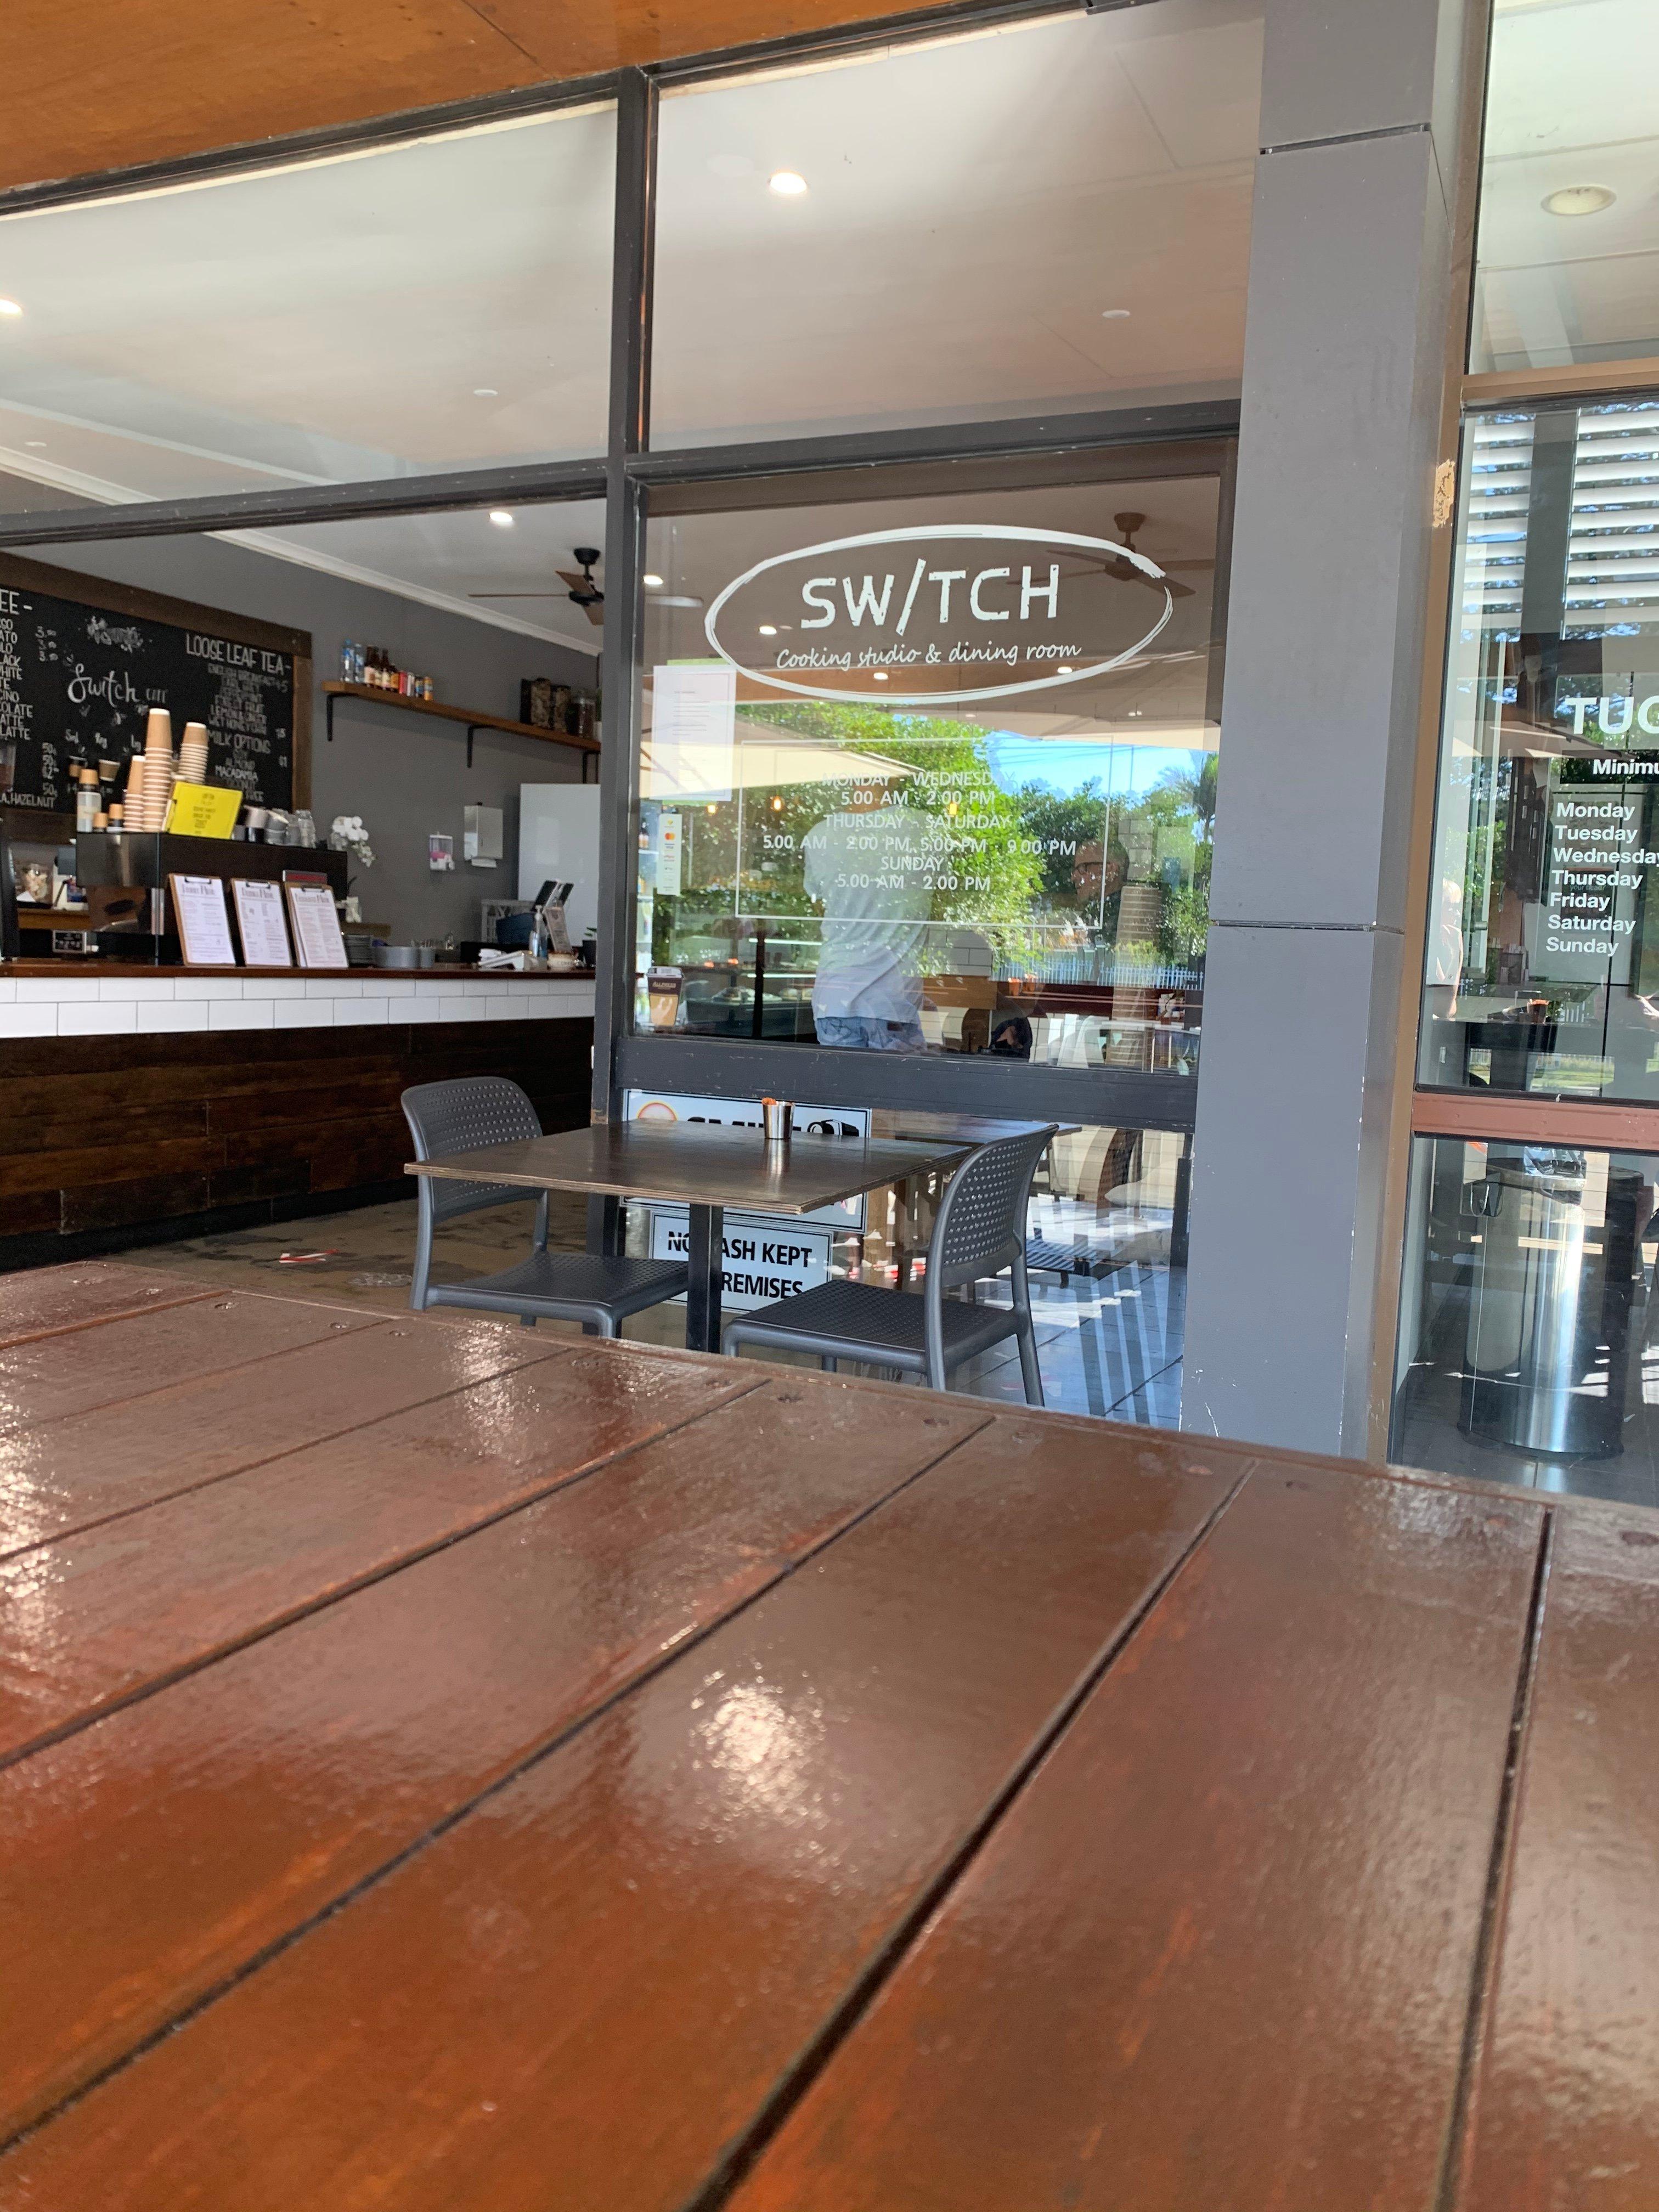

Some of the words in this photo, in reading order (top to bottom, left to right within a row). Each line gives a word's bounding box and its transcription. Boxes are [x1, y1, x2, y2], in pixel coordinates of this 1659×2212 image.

[186, 633, 225, 662] LOOSE
[227, 642, 258, 669] LEAF
[776, 647, 851, 672] Cooking
[857, 644, 922, 668] studio
[926, 643, 942, 664] &
[949, 640, 1018, 666] dining
[1026, 644, 1082, 660] room
[67, 663, 140, 708] Switch
[823, 772, 891, 787] MONDAY
[912, 771, 1016, 787] WEDNESDY
[841, 791, 873, 806] 5.00
[880, 791, 909, 805] AM
[926, 790, 962, 805] 2.00
[969, 791, 995, 805] PM
[1556, 802, 1635, 821] Monday
[823, 814, 905, 830] THURSDAY
[926, 814, 1012, 830] SATURDAY
[1554, 825, 1638, 844] Tuesday
[763, 834, 794, 849] 5.00
[800, 835, 827, 850] AM
[845, 836, 878, 850] 2.00
[920, 837, 956, 852] 5.00
[961, 838, 987, 853] PM
[1049, 840, 1077, 856] PM
[880, 855, 945, 871] SUNDAY
[1553, 847, 1659, 867] Wednesda
[837, 873, 870, 888] 5.00
[876, 874, 905, 889] AM
[922, 875, 958, 890] 2.00
[964, 876, 991, 891] PM
[1551, 869, 1643, 890] Thursday
[1550, 891, 1611, 911] Friday
[1547, 913, 1637, 934] Saturday
[1545, 936, 1620, 957] Sunday
[721, 1237, 756, 1261] ASH
[761, 1242, 813, 1268] KEPT
[721, 1271, 804, 1300] REMISES
